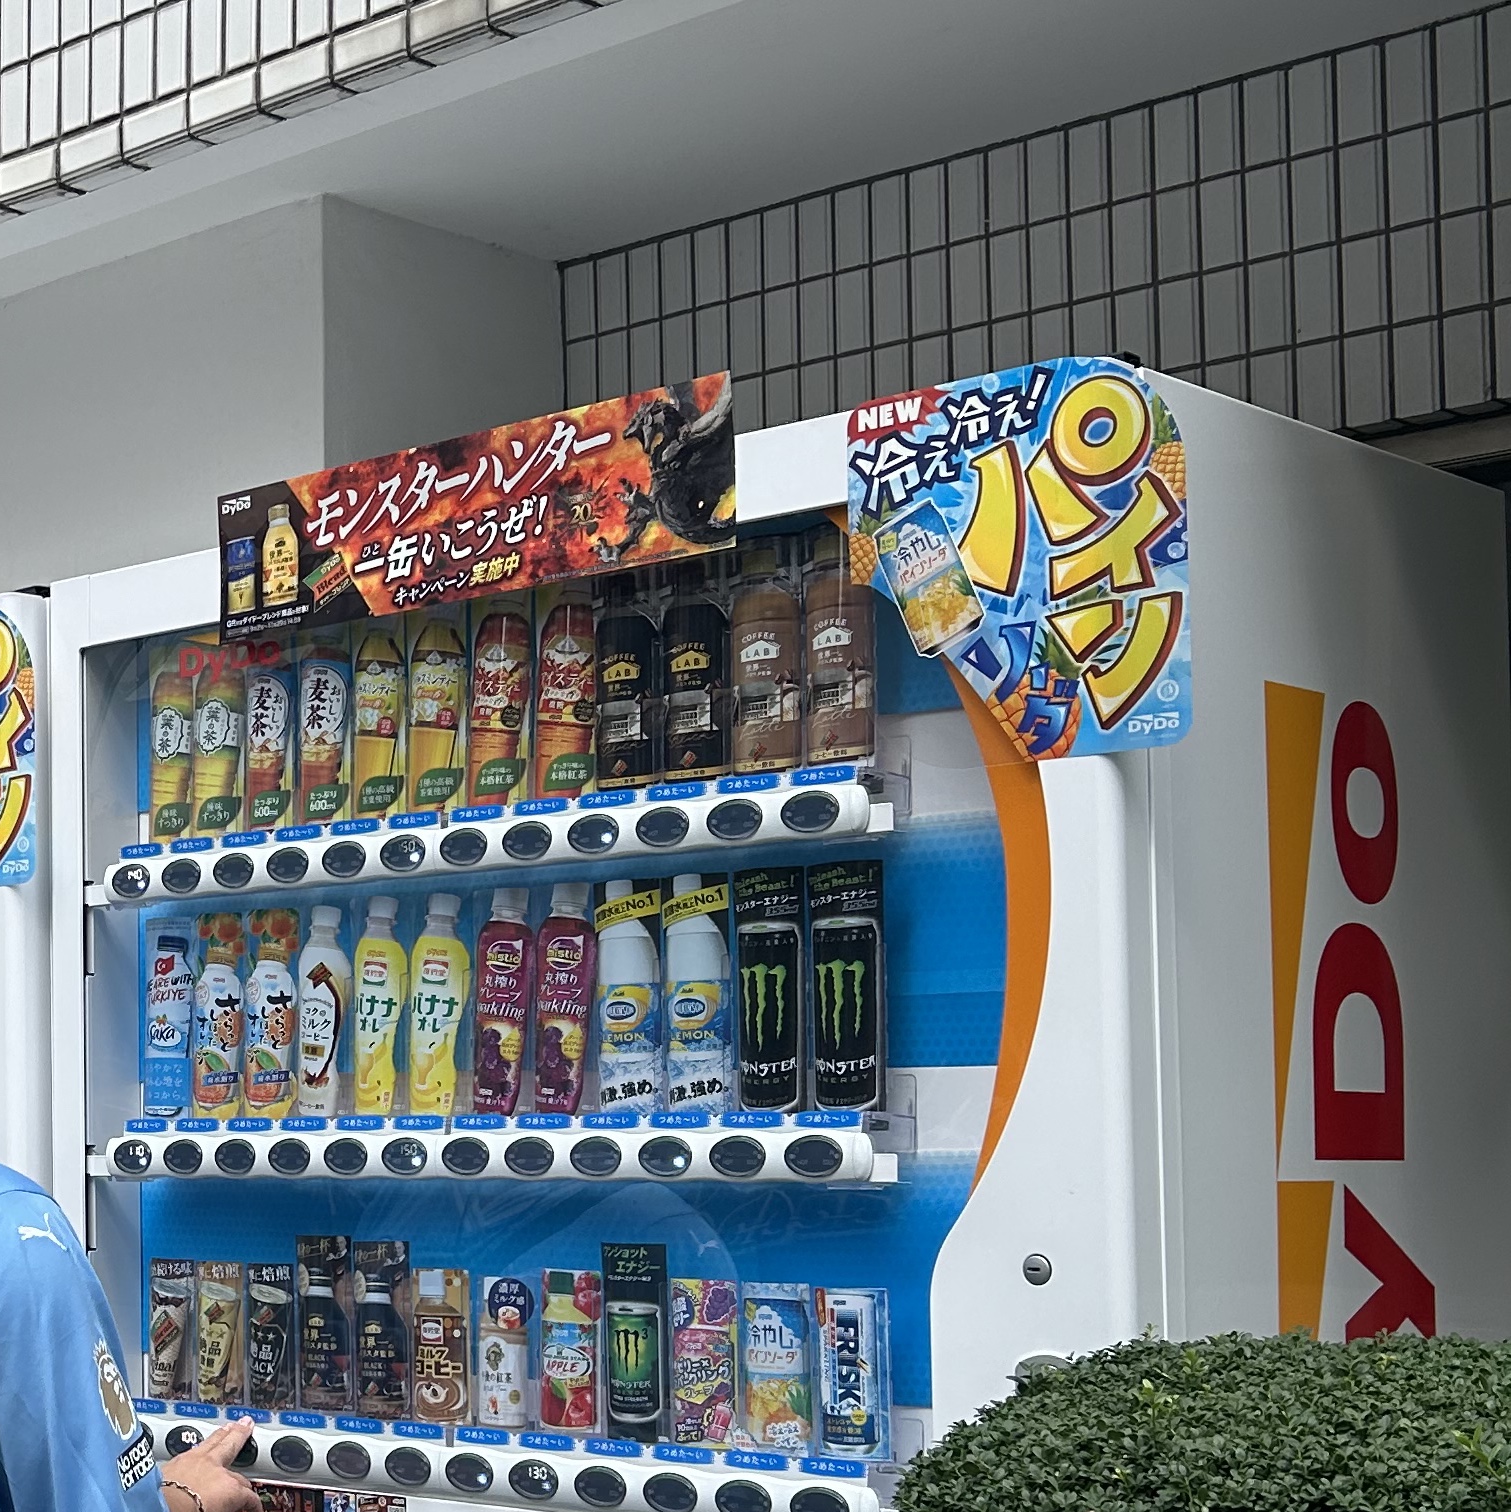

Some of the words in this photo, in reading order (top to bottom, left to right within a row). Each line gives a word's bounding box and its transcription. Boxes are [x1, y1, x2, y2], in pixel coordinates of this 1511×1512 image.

[857, 396, 924, 433] NEW
[855, 373, 1048, 514] 冷え冷え!
[306, 419, 612, 547] モンスターハンター
[221, 497, 251, 515] DyDo
[354, 494, 549, 583] 一缶いこうぜ!
[893, 531, 942, 571] 冷やし
[955, 374, 1185, 732] パイン
[394, 551, 521, 606] キャンペーン実施中
[813, 617, 848, 632] COFFEE
[741, 631, 776, 645] COFFEE
[817, 633, 842, 647] LAB
[672, 641, 706, 655] COFFEE
[745, 647, 771, 660] LAB
[178, 639, 281, 683] DyDo
[604, 652, 637, 665] COFFEE
[675, 657, 701, 670] LAB
[607, 668, 631, 679] LAB
[306, 676, 328, 731] 麦茶
[326, 685, 343, 731] おいしい
[250, 685, 272, 739] 麦茶
[270, 692, 285, 736] おいしい
[202, 705, 222, 747] 葉の茶
[1128, 712, 1180, 734] DyDo
[157, 713, 176, 755] 葉の茶
[550, 769, 588, 782] 本格紅茶
[801, 768, 845, 782] つめた～い
[308, 787, 338, 800] たっぷり
[656, 785, 696, 798] つめた～い
[522, 800, 557, 812] つめた～い
[157, 817, 185, 828] すっきり
[202, 810, 231, 823] すっきり
[396, 815, 429, 826] つめた～い
[282, 828, 312, 839] つめた～い
[176, 840, 205, 851] つめた～い
[1, 860, 30, 876] DyDo
[735, 894, 799, 913] モンスターエナジー
[810, 888, 878, 909] モンスターエナジー
[546, 946, 583, 961] mistio
[170, 973, 194, 987] WITH
[484, 973, 517, 990] 丸搾り
[544, 970, 578, 987] 丸搾り
[478, 986, 523, 1003] グレープ
[539, 983, 584, 1000] グレープ
[355, 992, 398, 1018] バナナ
[411, 991, 459, 1018] バナナ
[266, 990, 293, 1050] さらっと
[304, 1007, 327, 1018] コクの
[214, 993, 241, 1053] さらっと
[300, 1016, 332, 1031] ミルク
[1311, 700, 1436, 1343] yDo
[602, 1031, 646, 1043] LEMON
[670, 1029, 715, 1043] LEMON
[132, 1119, 158, 1129] つめた～い
[233, 1119, 265, 1129] つめた～い
[344, 1118, 377, 1128] つめた～い
[462, 1116, 498, 1126] つめた～い
[589, 1115, 629, 1125] つめた～い
[729, 1115, 772, 1124] つめた～い
[399, 1142, 418, 1156] 150
[603, 1245, 648, 1259] ワンショット
[615, 1260, 662, 1275] エナジー
[498, 1282, 521, 1294] 濃厚
[493, 1294, 526, 1306] ミルク感
[748, 1325, 795, 1349] 冷やし
[417, 1345, 450, 1361] ミルク
[545, 1360, 580, 1375] APPLE
[836, 1317, 862, 1405] FRISK
[415, 1359, 464, 1379] コーヒー
[684, 1384, 715, 1399] グレープ
[181, 1405, 209, 1415] つめた～い
[343, 1419, 374, 1430] つめた～い
[182, 1430, 197, 1444] 100
[464, 1430, 499, 1441] つめた～い
[593, 1441, 631, 1452] つめた～い
[116, 1455, 132, 1474] No
[734, 1454, 776, 1466] つめた～い
[120, 1469, 136, 1492] for
[527, 1467, 548, 1481] 130
